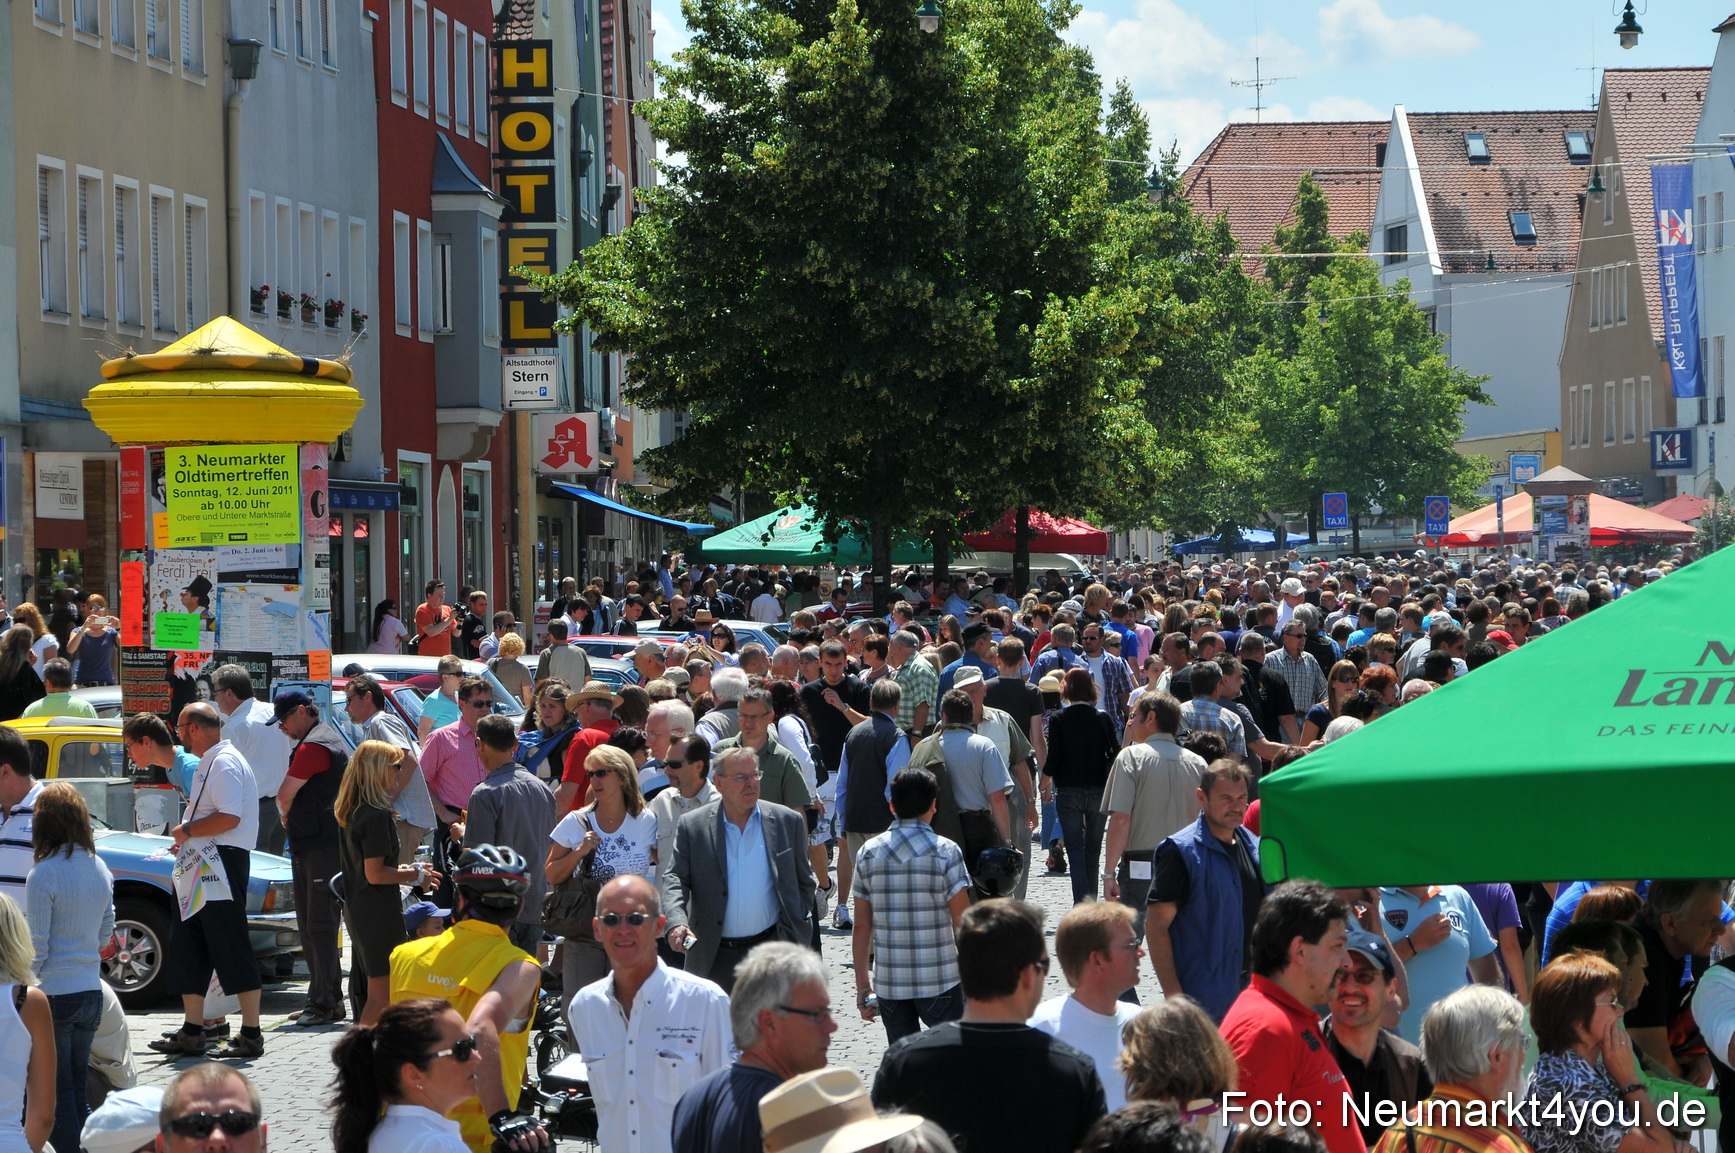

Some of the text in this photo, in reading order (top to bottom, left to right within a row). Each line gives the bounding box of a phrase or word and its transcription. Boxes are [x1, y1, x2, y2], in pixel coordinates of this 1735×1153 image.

[501, 48, 552, 340] HOTEL
[506, 359, 555, 367] Altstadthotel
[512, 371, 549, 382] Stern
[179, 455, 192, 467] 3.
[197, 452, 286, 466] Neumarkter
[175, 467, 289, 483] Oldtimertreffen
[173, 485, 293, 499] Sonntag, 12. Juni 2011
[201, 499, 271, 510] ab 10.00 Uhr
[177, 510, 292, 521] Obere und Untere Marktstraße
[1326, 517, 1346, 525] TAXI
[1428, 523, 1447, 532] TAXI
[167, 556, 202, 564] Zauberclown
[157, 564, 212, 579] Ferdi Frei
[1596, 724, 1657, 737] DAS
[472, 866, 495, 875] uvex
[1450, 914, 1460, 928] 37
